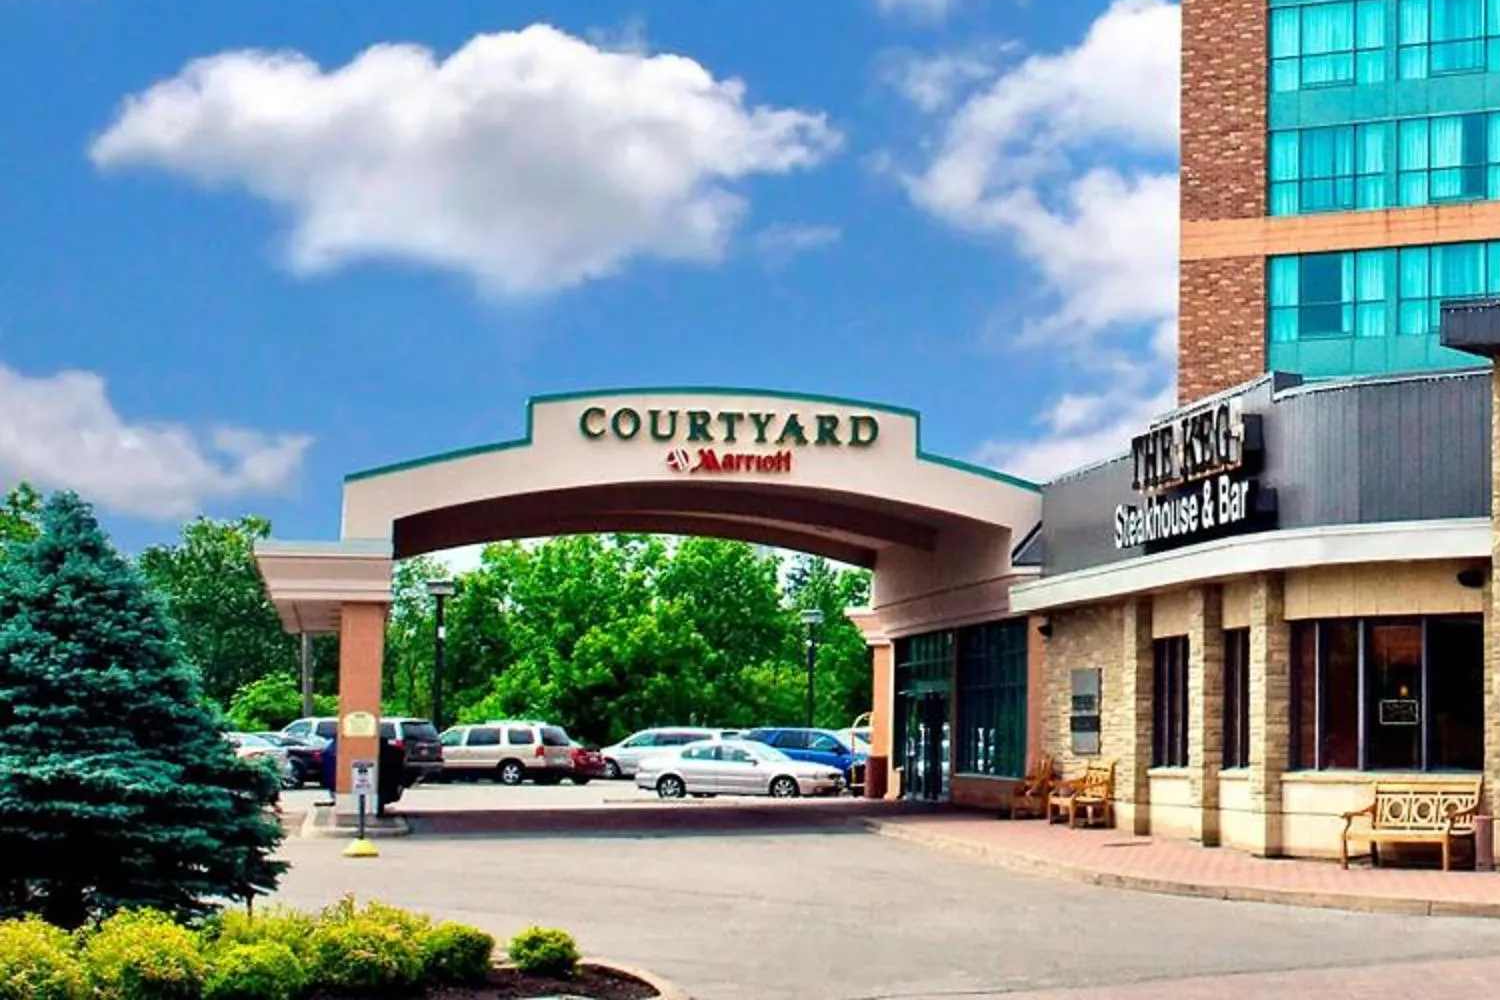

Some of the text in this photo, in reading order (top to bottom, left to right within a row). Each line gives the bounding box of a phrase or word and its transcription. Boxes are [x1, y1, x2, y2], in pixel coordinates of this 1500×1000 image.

[580, 407, 879, 446] COURTYARD
[690, 448, 792, 474] Marriott
[1114, 474, 1249, 549] Steakhouse & Bar
